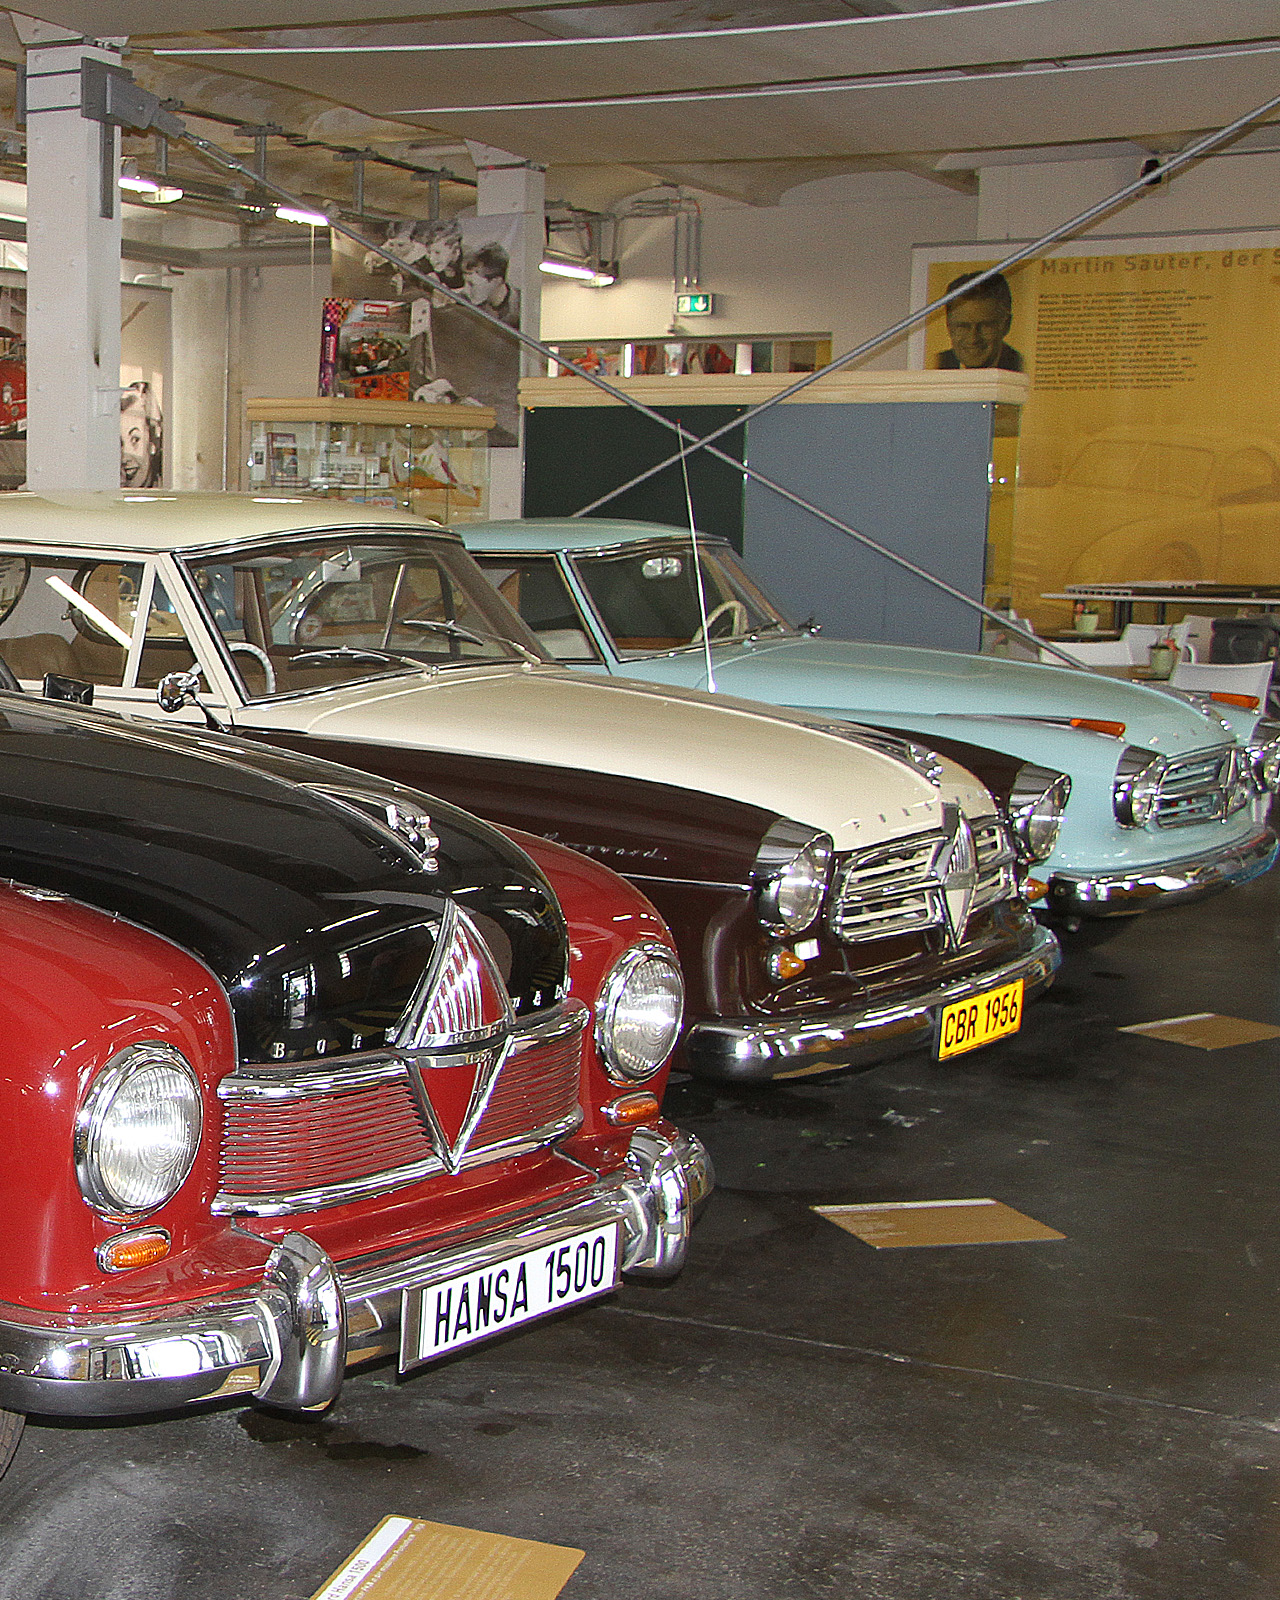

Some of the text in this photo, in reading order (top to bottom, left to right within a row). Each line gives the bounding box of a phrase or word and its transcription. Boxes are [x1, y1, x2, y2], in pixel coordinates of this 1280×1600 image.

[1040, 256, 1114, 275] Martin
[1221, 251, 1262, 268] der
[945, 990, 1018, 1048] CBR 1956
[434, 1236, 605, 1347] HANSA 1500
[331, 1575, 356, 1594] Hansa
[349, 1559, 370, 1573] 1500
